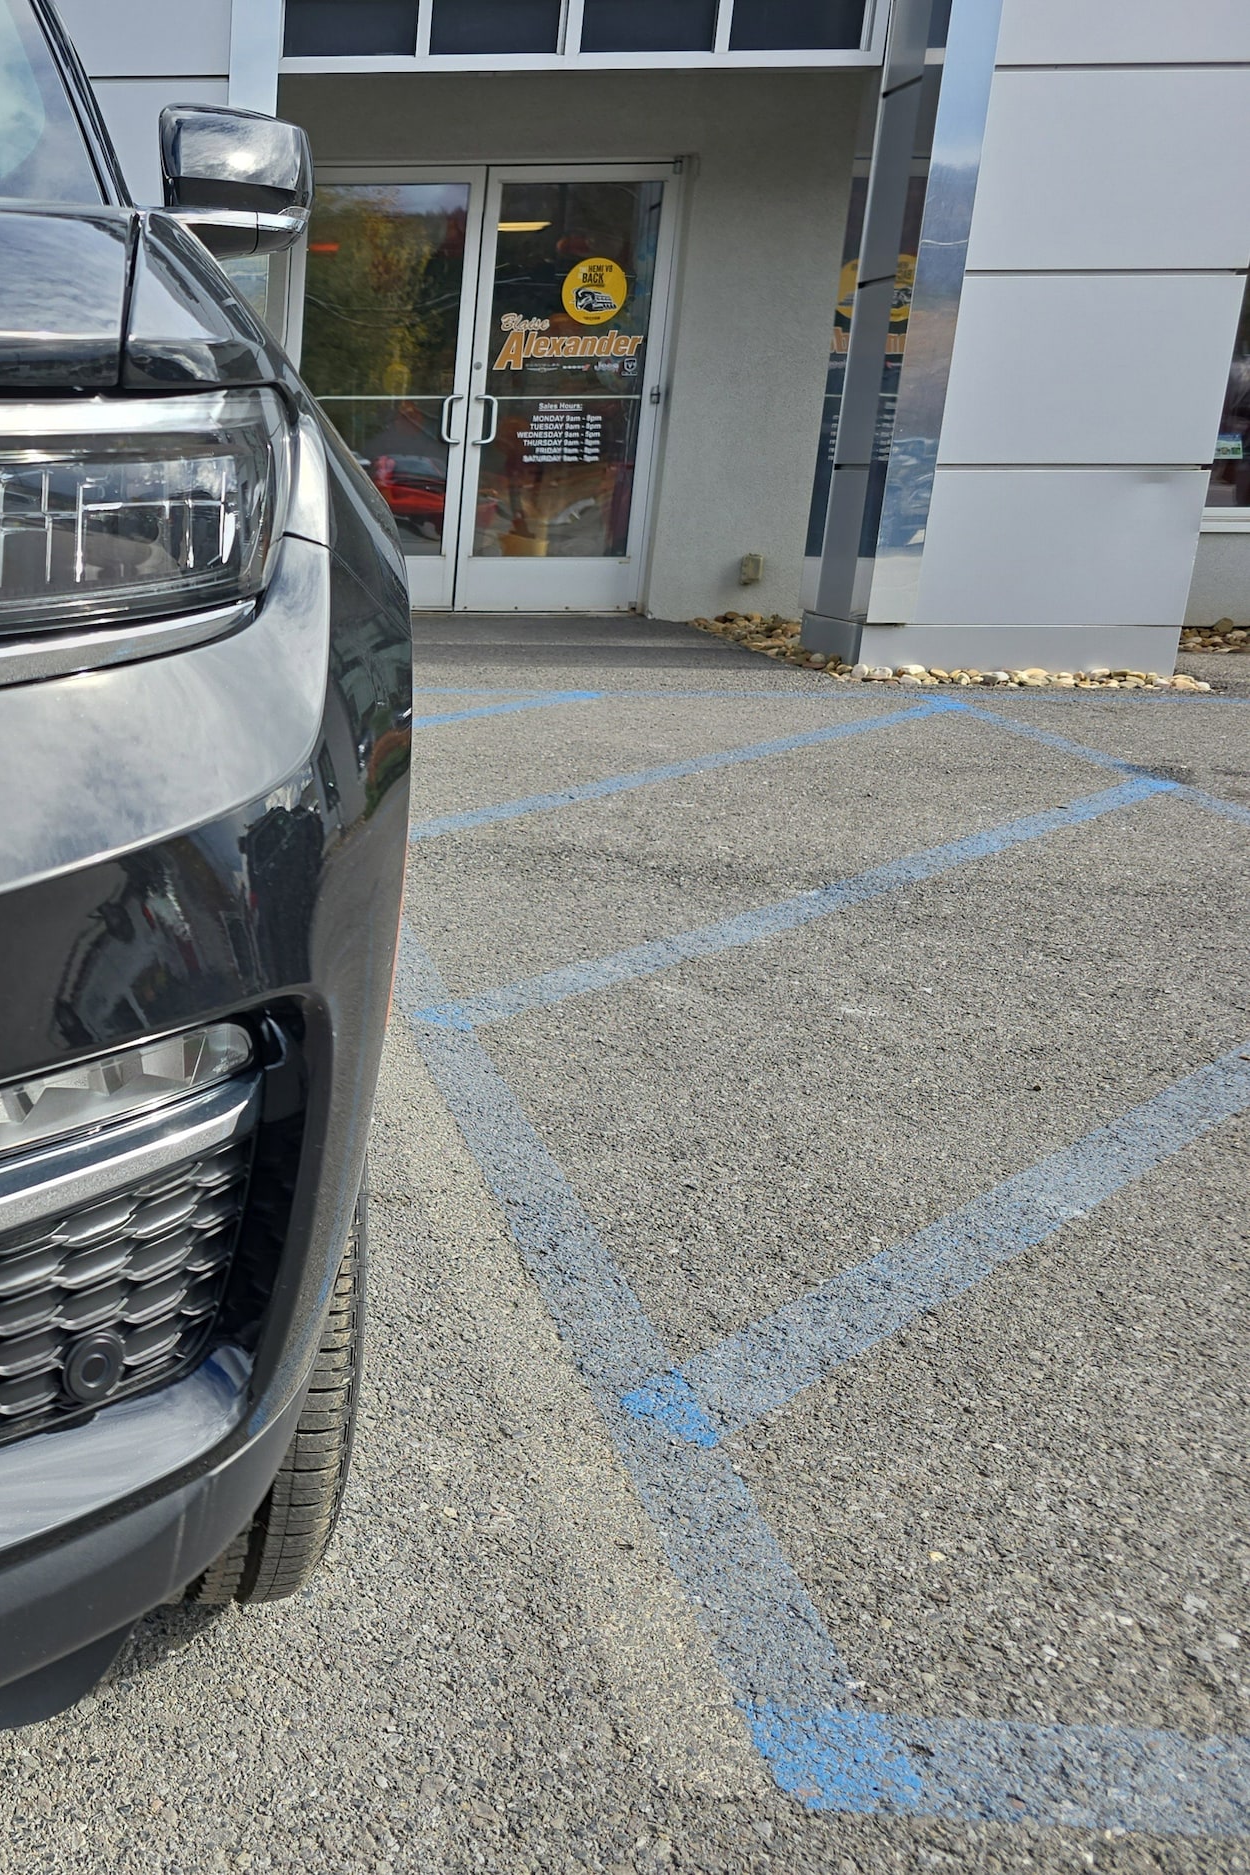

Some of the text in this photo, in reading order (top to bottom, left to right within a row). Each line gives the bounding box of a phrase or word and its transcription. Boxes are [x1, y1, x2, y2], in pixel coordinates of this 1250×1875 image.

[582, 272, 604, 283] BACK
[500, 312, 550, 331] Blaise
[492, 330, 643, 370] Alexander
